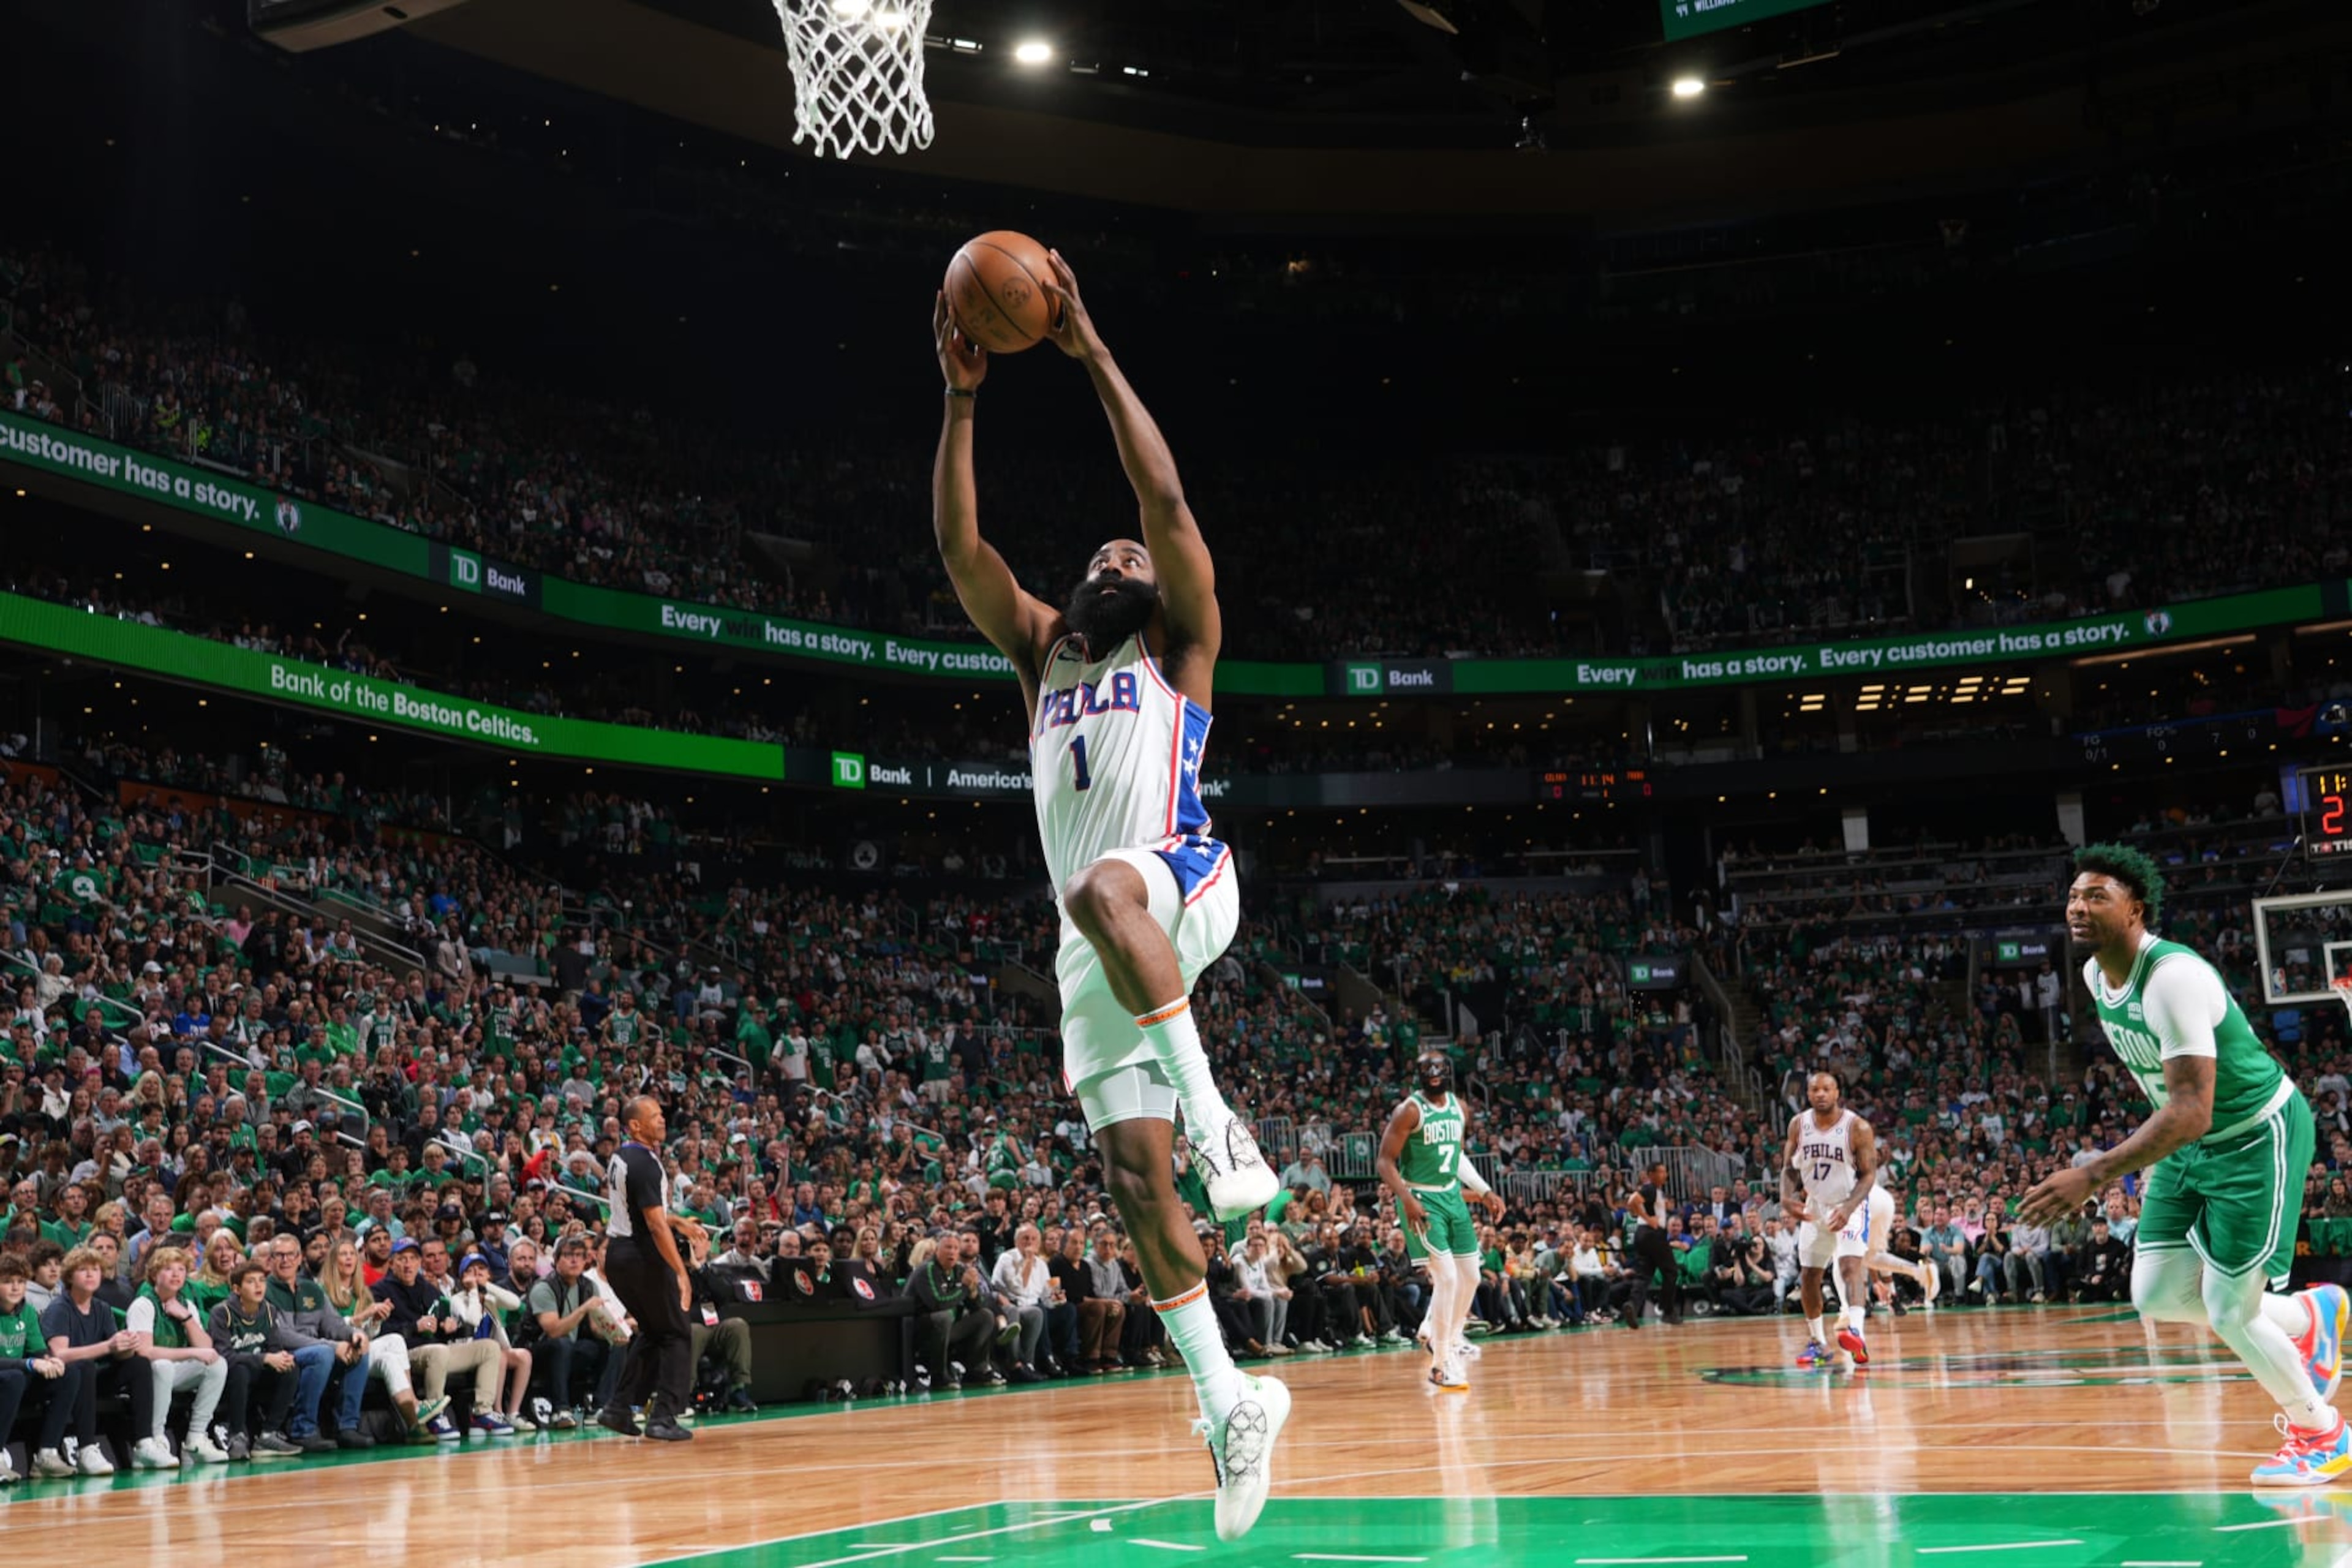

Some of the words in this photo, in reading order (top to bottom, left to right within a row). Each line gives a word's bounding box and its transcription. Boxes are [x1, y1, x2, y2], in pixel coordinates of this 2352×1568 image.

[124, 451, 170, 492] has
[174, 477, 190, 499] a
[194, 482, 260, 521] story.
[453, 554, 479, 584] TD
[488, 567, 526, 595] Bank
[662, 604, 722, 638] Every
[765, 620, 802, 647] has
[804, 632, 818, 649] a
[821, 633, 875, 661] story.
[885, 640, 940, 671] Every
[1577, 663, 1637, 686] Every
[1682, 660, 1724, 679] has
[1726, 660, 1742, 676] a
[1744, 654, 1807, 675] story.
[1819, 647, 1883, 668] Every
[1886, 638, 1996, 662] customer
[1999, 633, 2043, 652] has
[2045, 632, 2061, 648] a
[2064, 622, 2130, 646] story.
[1351, 668, 1379, 690] TD
[1389, 669, 1434, 687] Bank
[271, 663, 326, 698] Bank
[330, 680, 352, 704] of
[355, 685, 390, 712] the
[393, 692, 464, 728] Boston
[466, 709, 540, 744] Celtics.
[1040, 672, 1139, 737] PHILA
[835, 757, 862, 782] TD
[870, 764, 912, 785] Bank
[946, 768, 1033, 790] America's
[1069, 735, 1090, 791] 1
[2323, 796, 2345, 834] 2
[1438, 1144, 1455, 1174] 7
[1803, 1144, 1844, 1163] PHILA
[1813, 1163, 1831, 1181] 17
